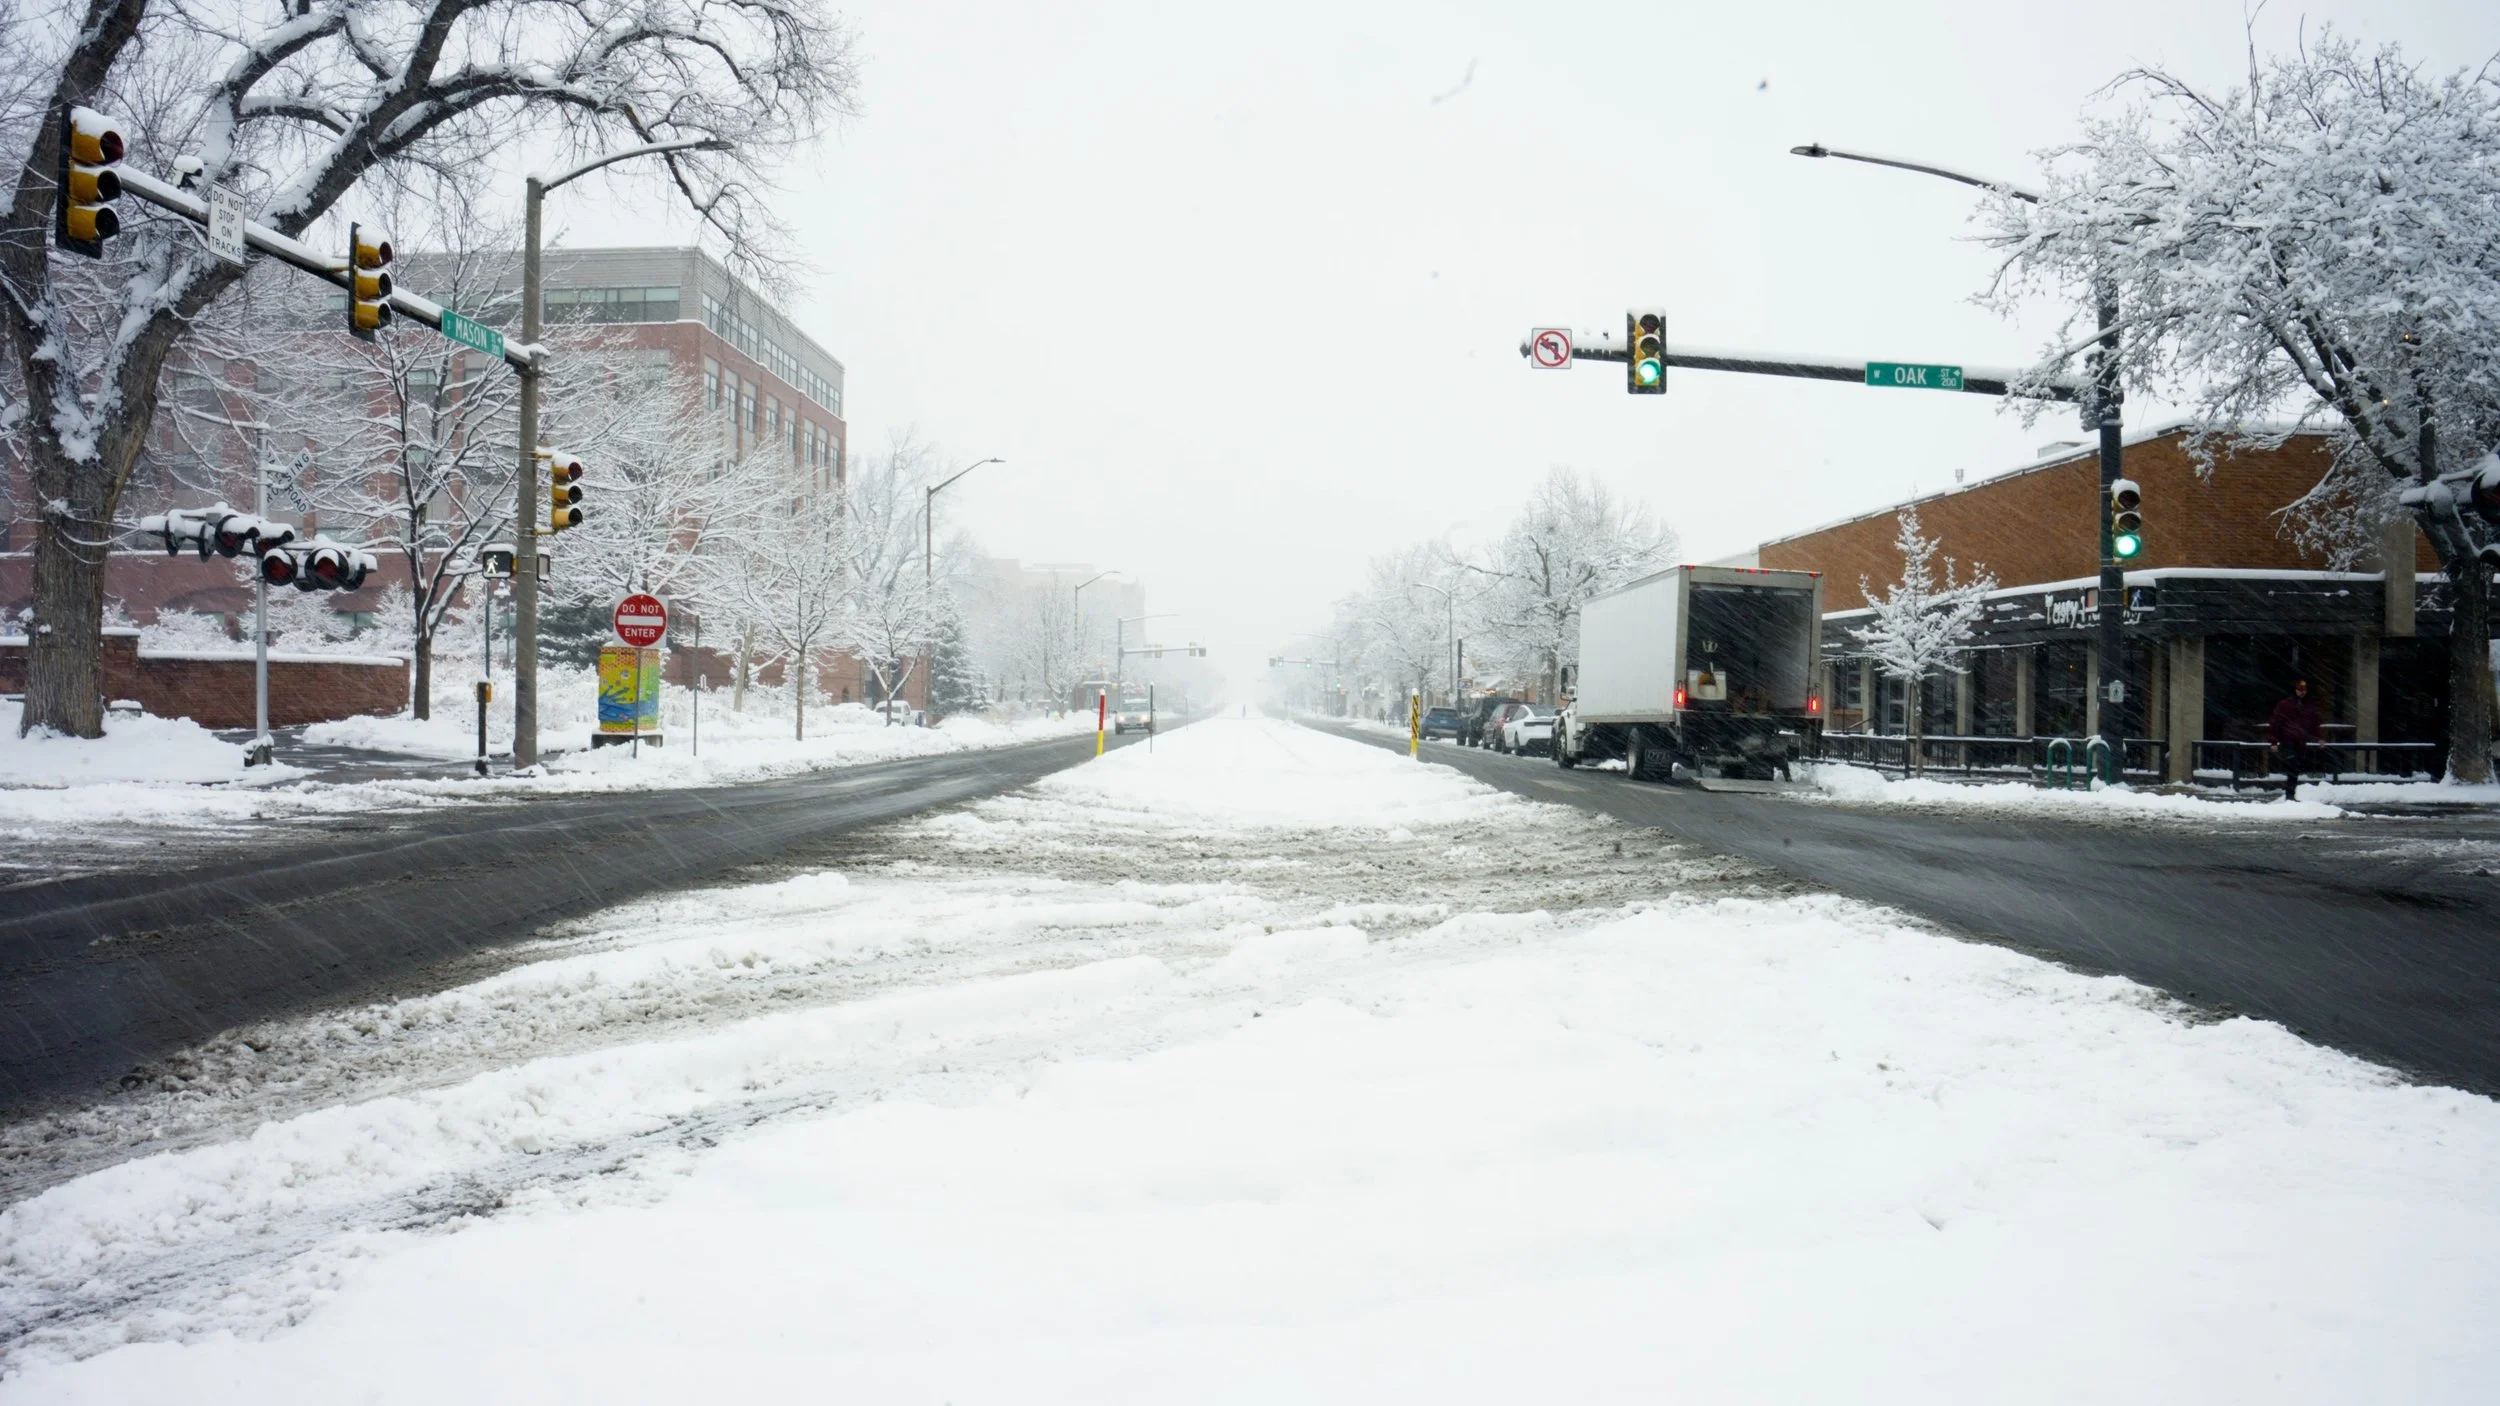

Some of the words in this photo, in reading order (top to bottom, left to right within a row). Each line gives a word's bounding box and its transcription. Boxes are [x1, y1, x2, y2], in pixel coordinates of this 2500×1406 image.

[213, 190, 224, 205] DO
[228, 196, 243, 213] NOT
[218, 208, 235, 224] STOP
[221, 225, 232, 239] ON
[211, 235, 241, 258] TRACKS
[455, 317, 487, 349] MASON
[1873, 369, 1880, 379] W
[1894, 366, 1927, 385] OAK
[1940, 368, 1949, 377] ST
[1941, 377, 1957, 387] 200
[622, 604, 636, 613] DO
[640, 604, 660, 614] NOT
[624, 627, 656, 638] ENTER
